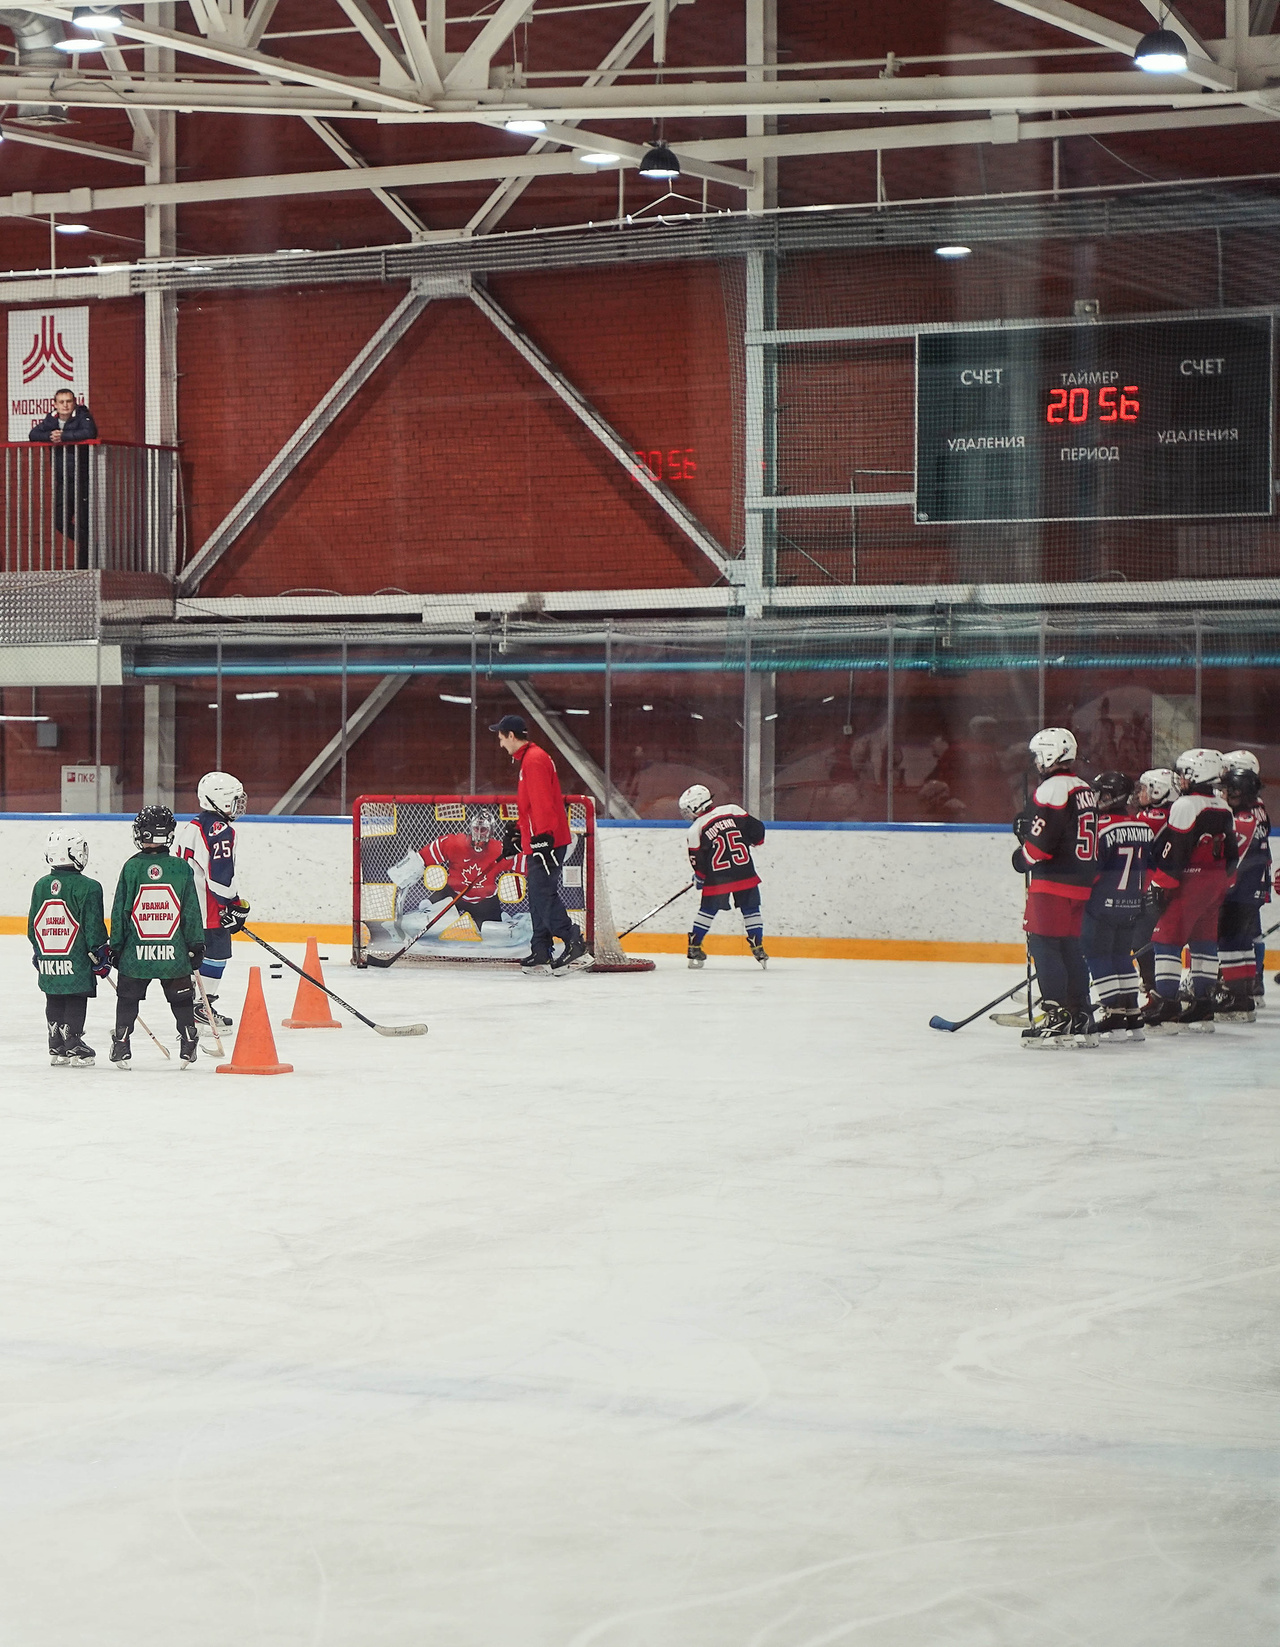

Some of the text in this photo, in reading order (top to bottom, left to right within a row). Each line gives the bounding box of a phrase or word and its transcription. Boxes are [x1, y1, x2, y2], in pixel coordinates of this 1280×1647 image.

[1180, 358, 1224, 375] СЧЕТ
[960, 369, 1003, 386] СЧЕТ
[1060, 371, 1119, 385] ТАЙМЕР
[12, 393, 85, 415] МОСКОВЙ
[1047, 386, 1140, 423] 20 56
[947, 436, 1025, 452] УДАЛЕНИЯ
[1157, 428, 1239, 444] УДАЛЕНИЯ
[1060, 447, 1120, 462] ПЕРИОД
[1075, 811, 1099, 861] 5
[212, 840, 232, 860] 25
[711, 830, 750, 871] 25
[1117, 846, 1142, 891] 7
[141, 900, 170, 910] УВАЖАЙ
[138, 913, 174, 921] ПАРТНЕРА!
[135, 945, 176, 961] VIKHR
[38, 959, 74, 976] VIKHR
